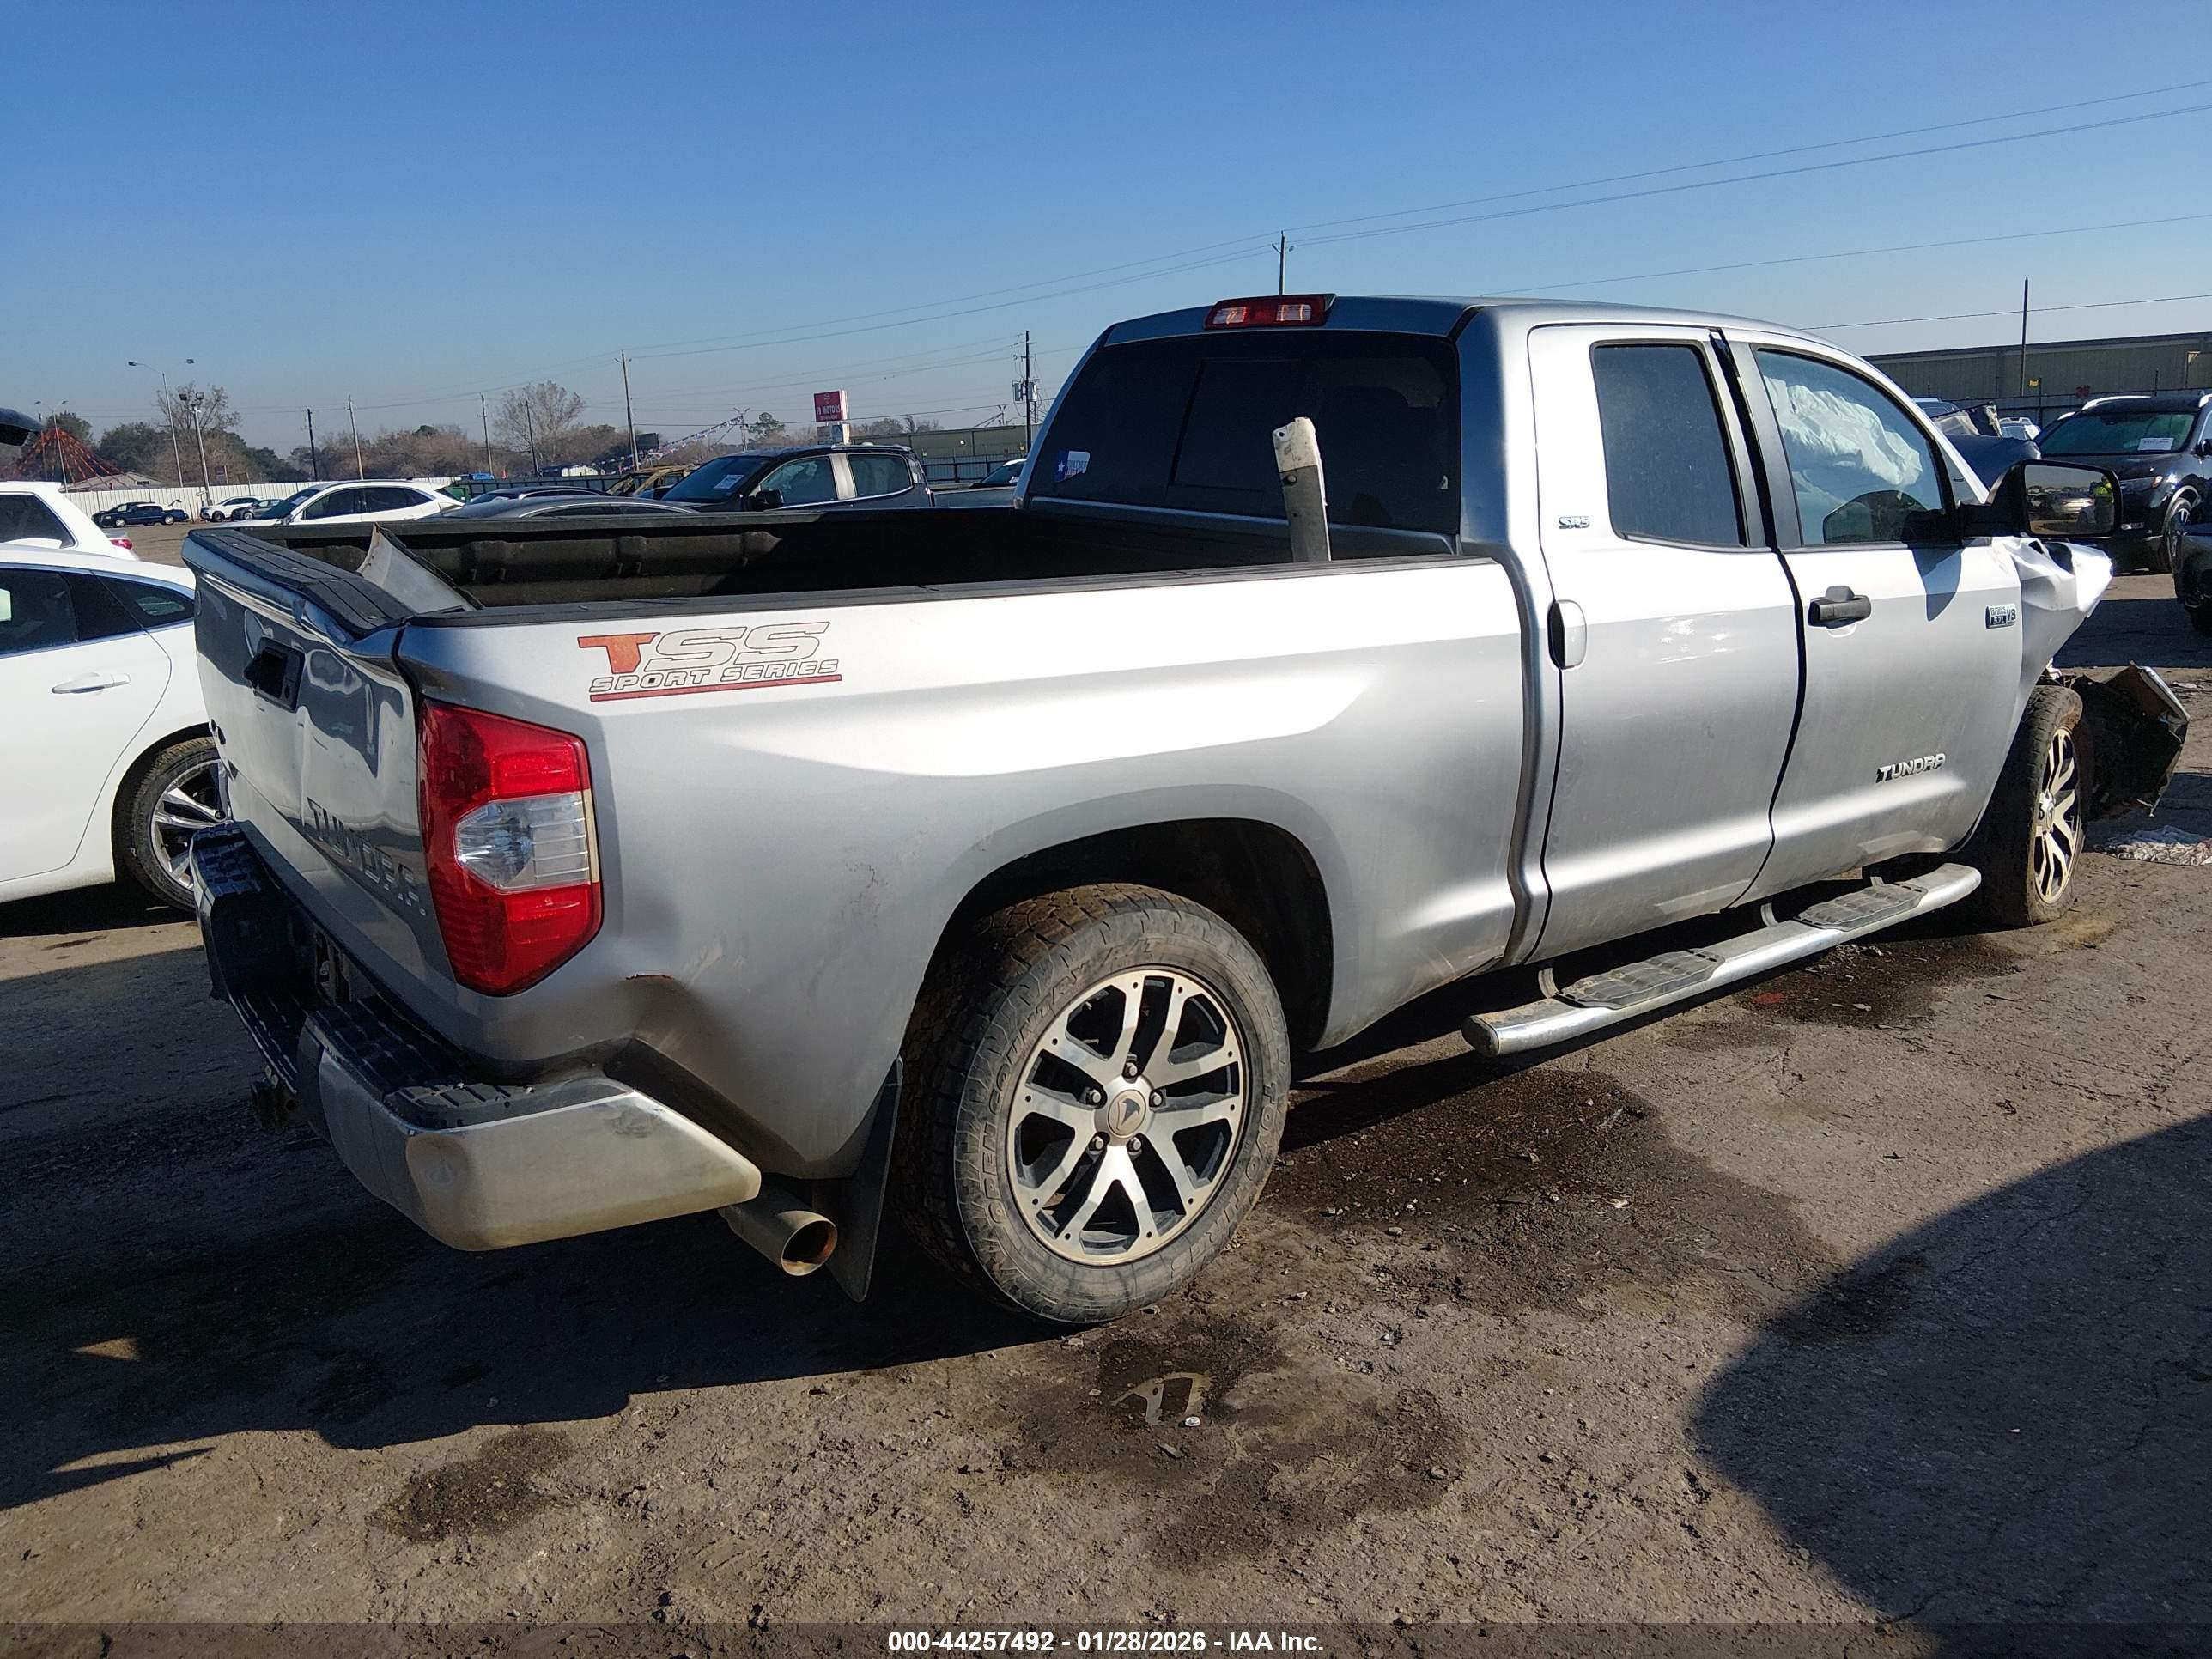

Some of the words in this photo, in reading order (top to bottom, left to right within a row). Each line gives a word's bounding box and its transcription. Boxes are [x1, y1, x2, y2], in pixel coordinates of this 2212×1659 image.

[577, 622, 830, 674] TSS
[590, 669, 711, 693] SPORT
[720, 659, 839, 683] SERIES
[1875, 752, 1947, 783] TUNDRA
[981, 1121, 1006, 1224] OPEN
